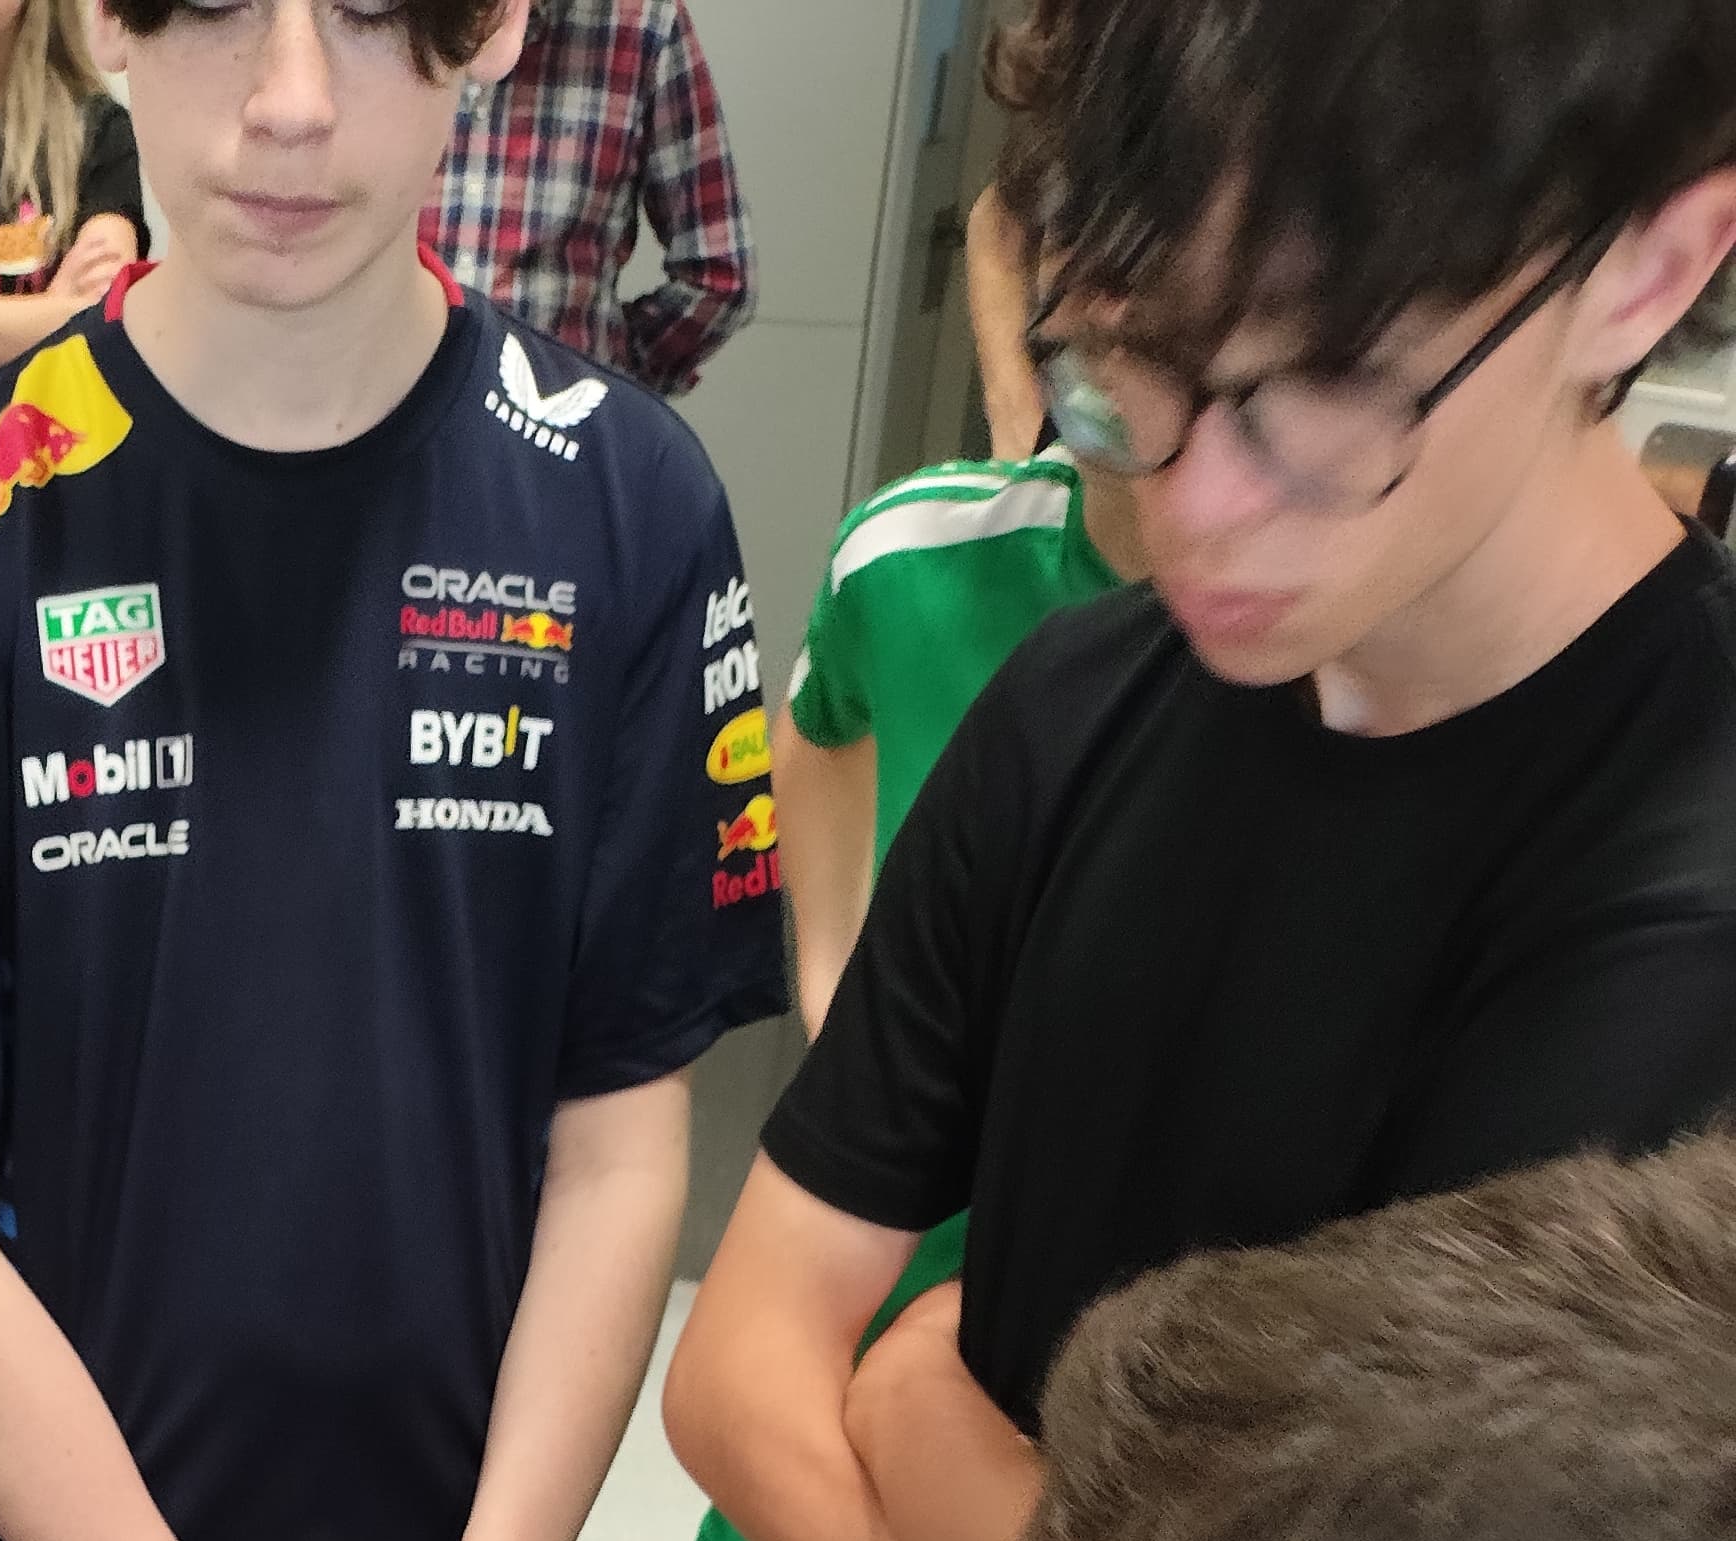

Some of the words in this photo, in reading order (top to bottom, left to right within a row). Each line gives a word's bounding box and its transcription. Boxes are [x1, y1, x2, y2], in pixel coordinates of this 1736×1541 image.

[401, 563, 577, 615] ORACLE
[48, 594, 155, 641] TAG
[48, 637, 159, 692] HEUER
[398, 649, 570, 684] RACING
[410, 704, 554, 770] BYBIT
[21, 739, 152, 808] Mobil
[394, 797, 554, 837] HONDA
[31, 819, 191, 872] ORACLE
